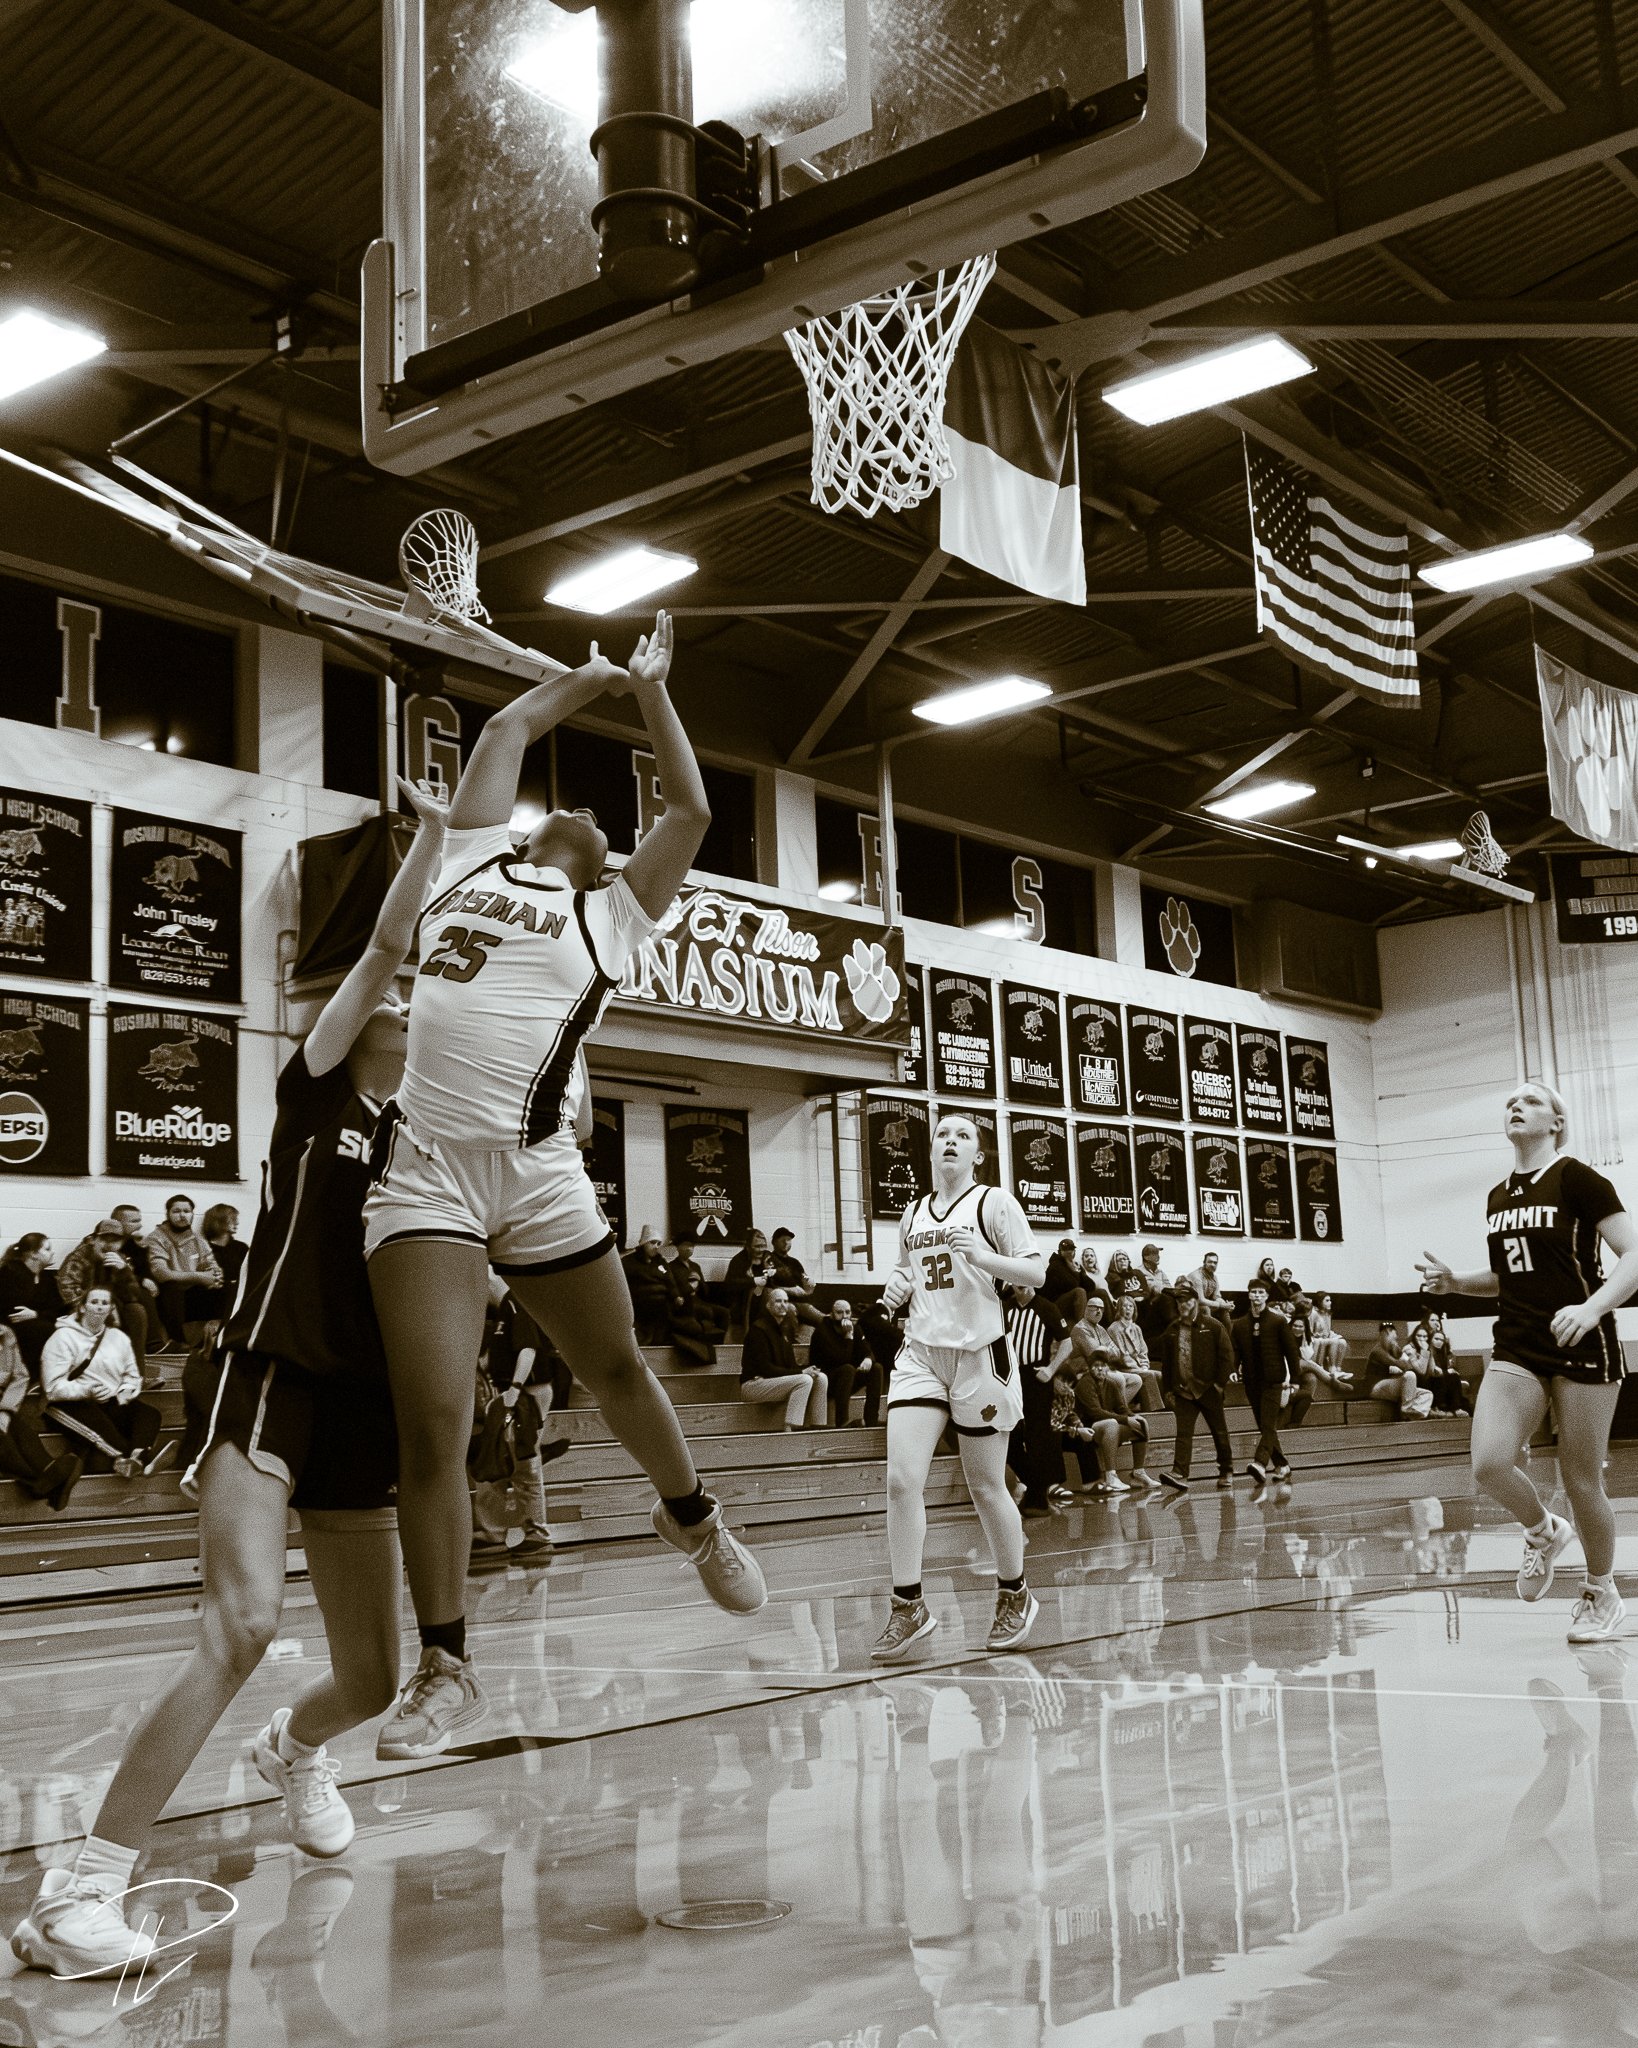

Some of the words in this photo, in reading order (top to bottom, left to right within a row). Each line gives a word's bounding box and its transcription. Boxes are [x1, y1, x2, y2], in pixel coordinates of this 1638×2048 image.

[0, 879, 34, 895] Credit
[36, 886, 67, 912] Union
[1012, 855, 1046, 945] S
[133, 903, 167, 921] John
[170, 908, 218, 931] Tinsley
[1603, 915, 1638, 937] 199
[751, 906, 821, 962] Tilson
[419, 925, 503, 983] 25
[3, 998, 33, 1017] HIGH
[35, 1001, 82, 1031] SCHOOL
[113, 1013, 160, 1034] ROSMAN
[162, 1013, 190, 1032] HIGH
[191, 1017, 233, 1045] SCHOOL
[952, 1033, 990, 1051] LANDSCAPING
[946, 1048, 989, 1064] HYDROSEEDING
[1022, 1057, 1052, 1078] United
[1086, 1057, 1092, 1068] L
[1095, 1058, 1101, 1069] B
[1104, 1059, 1112, 1070] M
[1048, 1079, 1060, 1089] Bank
[1191, 1069, 1232, 1089] QUEBEC
[1085, 1093, 1116, 1105] TRUCKING
[1198, 1105, 1230, 1119] 884-8712
[0, 1119, 44, 1136] EPSI
[115, 1109, 232, 1147] BlueRidge
[1090, 1196, 1134, 1213] PARDEE
[1488, 1205, 1558, 1234] UMMIT
[1503, 1236, 1534, 1274] 21
[922, 1252, 954, 1291] 32
